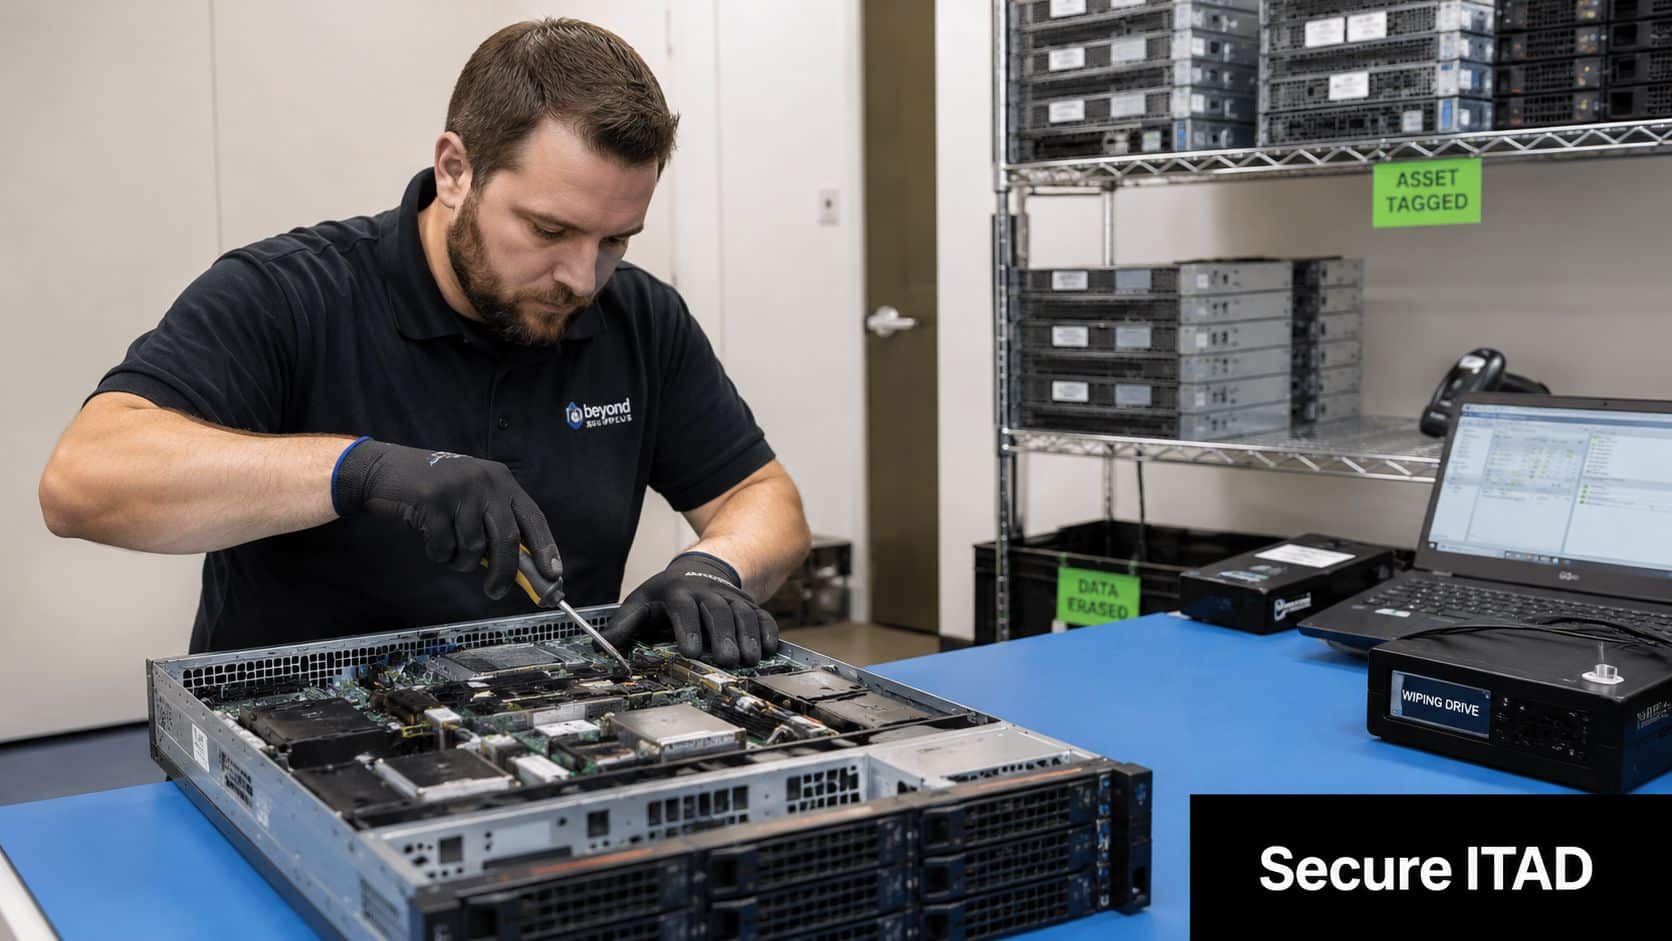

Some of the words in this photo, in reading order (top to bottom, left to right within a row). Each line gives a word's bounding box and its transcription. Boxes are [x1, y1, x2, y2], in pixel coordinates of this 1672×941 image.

[1396, 168, 1459, 188] ASSET
[1386, 193, 1468, 213] TAGGED
[583, 397, 631, 420] beyond
[1078, 579, 1119, 598] DATA
[1067, 597, 1129, 620] ERASED
[1402, 689, 1442, 708] WIPING
[1445, 699, 1479, 717] DRIVE
